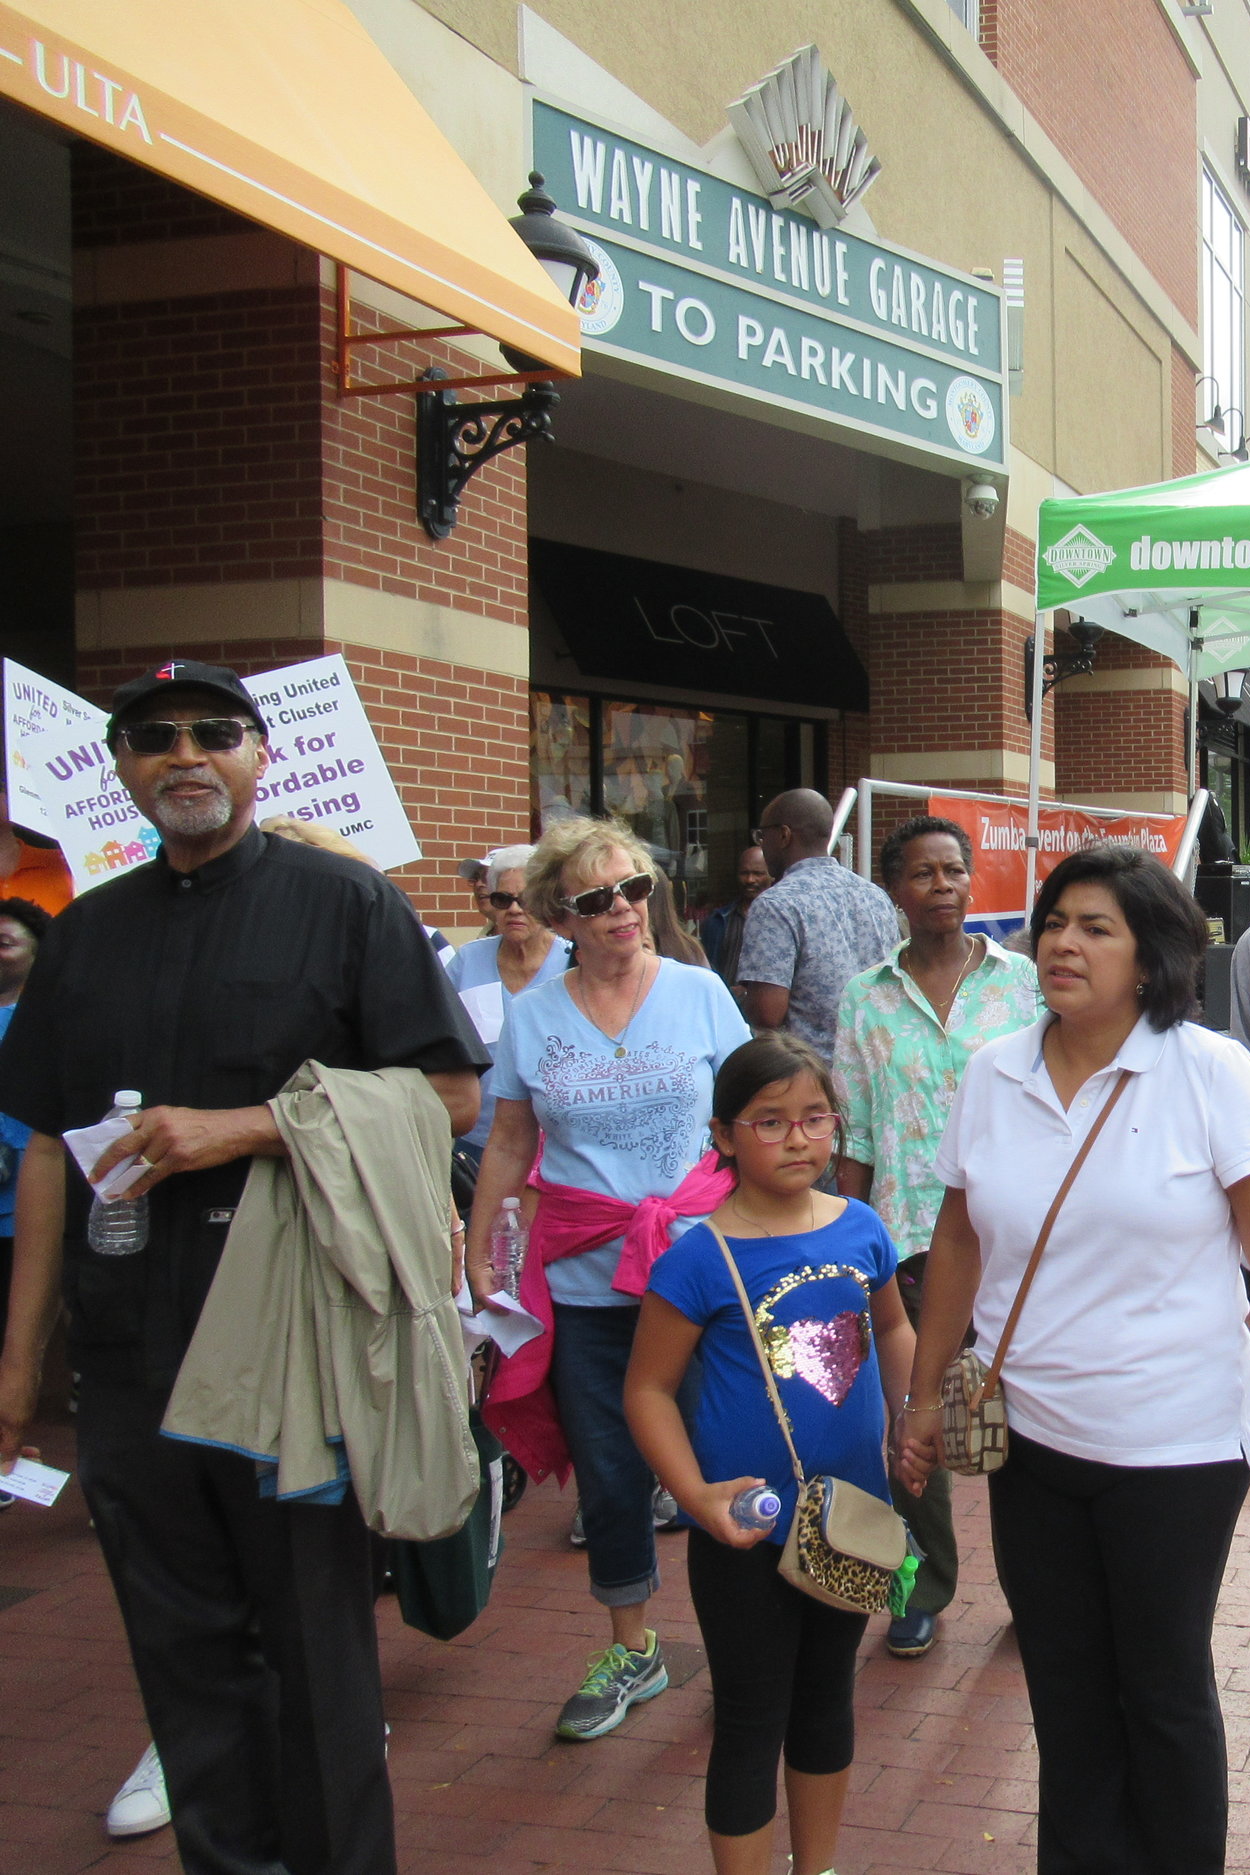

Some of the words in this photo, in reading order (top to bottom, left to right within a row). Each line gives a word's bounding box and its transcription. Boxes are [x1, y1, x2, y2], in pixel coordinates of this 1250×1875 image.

[33, 38, 153, 145] ULTA
[569, 129, 703, 251] WAYNE
[728, 196, 850, 306] AVENUE
[869, 257, 979, 356] GARAGE
[638, 280, 716, 345] TO
[737, 314, 939, 420] PARKING
[1050, 548, 1110, 563] DOWNTOWN
[633, 596, 778, 659] LOFT
[13, 682, 58, 718] UNITED
[284, 672, 341, 698] United
[278, 700, 340, 725] Cluster
[294, 731, 336, 756] for
[255, 757, 365, 802] ordable
[339, 819, 374, 838] UMC
[980, 817, 1026, 851] Zumba
[1037, 825, 1065, 853] vent
[1066, 832, 1081, 852] on
[1140, 827, 1168, 853] Plaza
[572, 1077, 670, 1105] AMERICA
